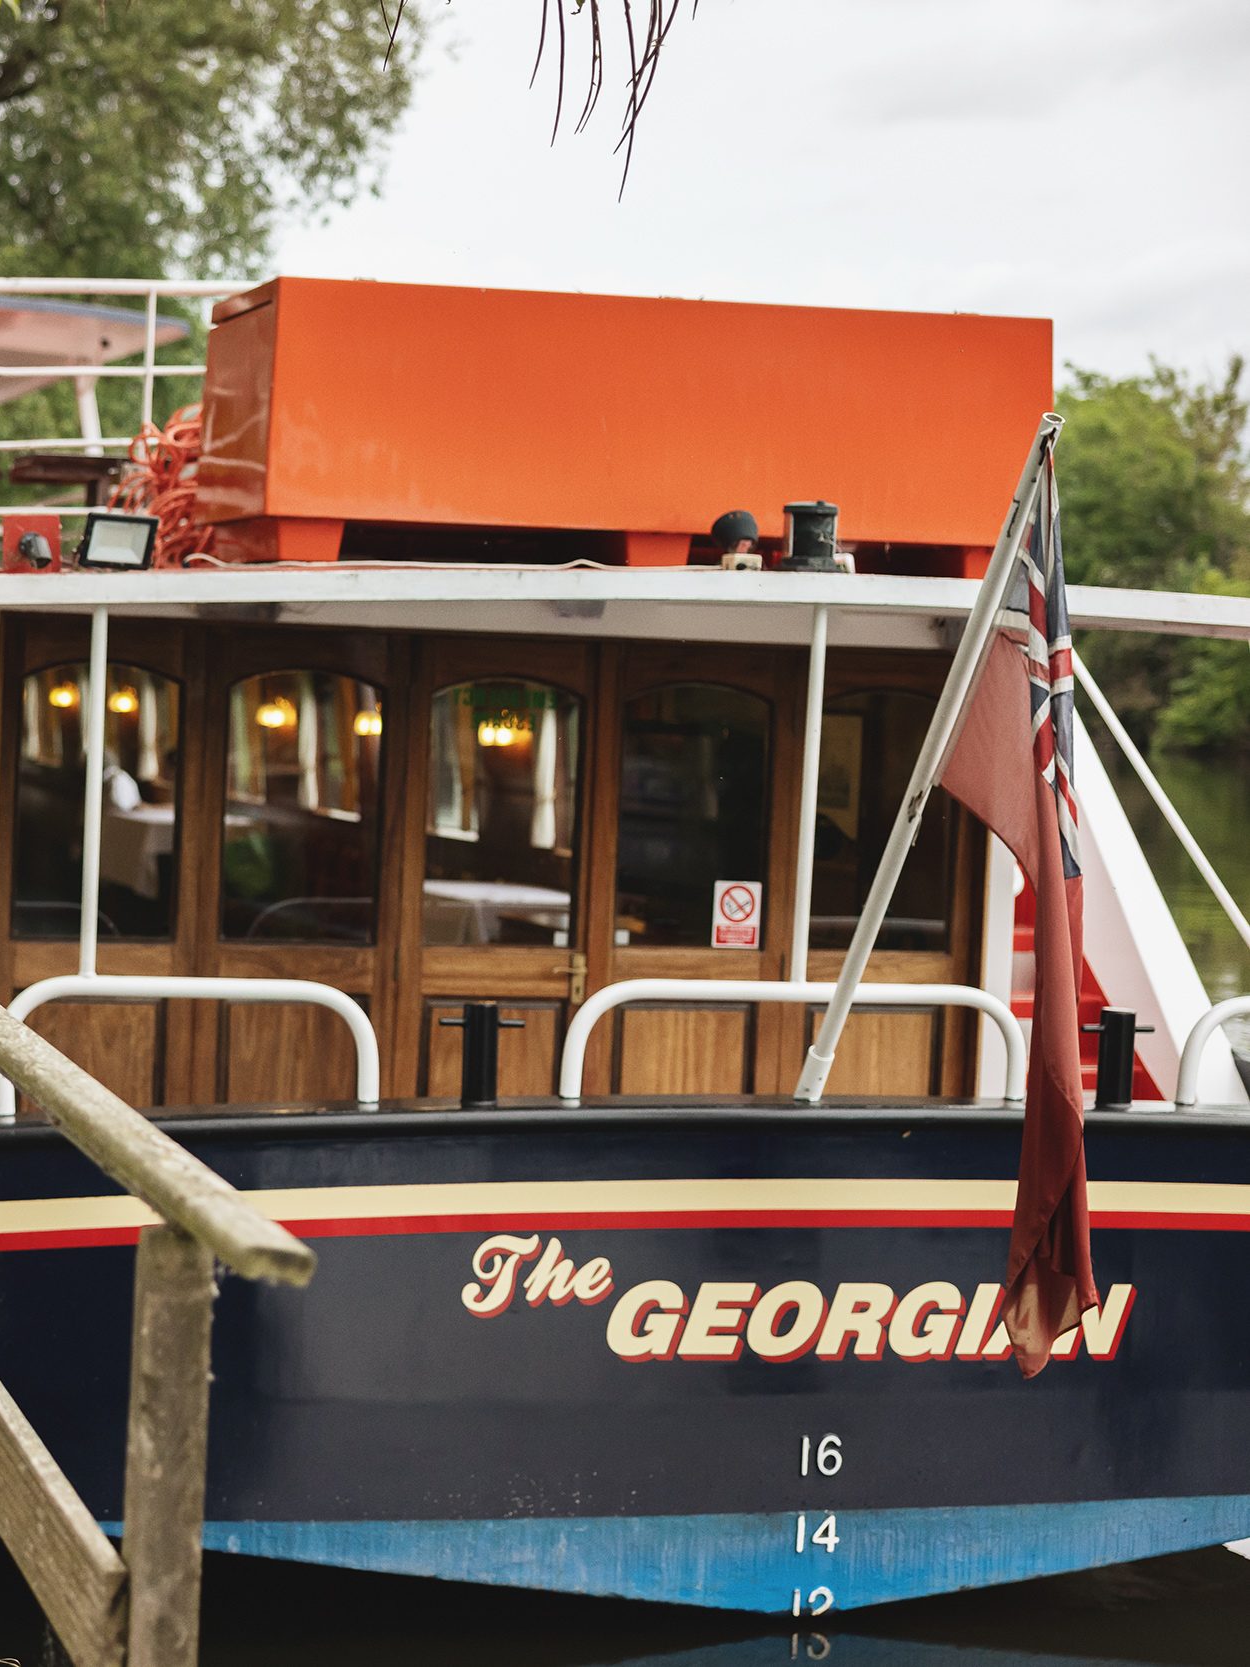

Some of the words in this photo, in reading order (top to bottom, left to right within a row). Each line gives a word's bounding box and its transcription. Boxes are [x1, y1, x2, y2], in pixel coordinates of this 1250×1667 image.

[461, 1234, 615, 1319] The
[799, 1433, 843, 1476] 16
[796, 1514, 840, 1553] 14
